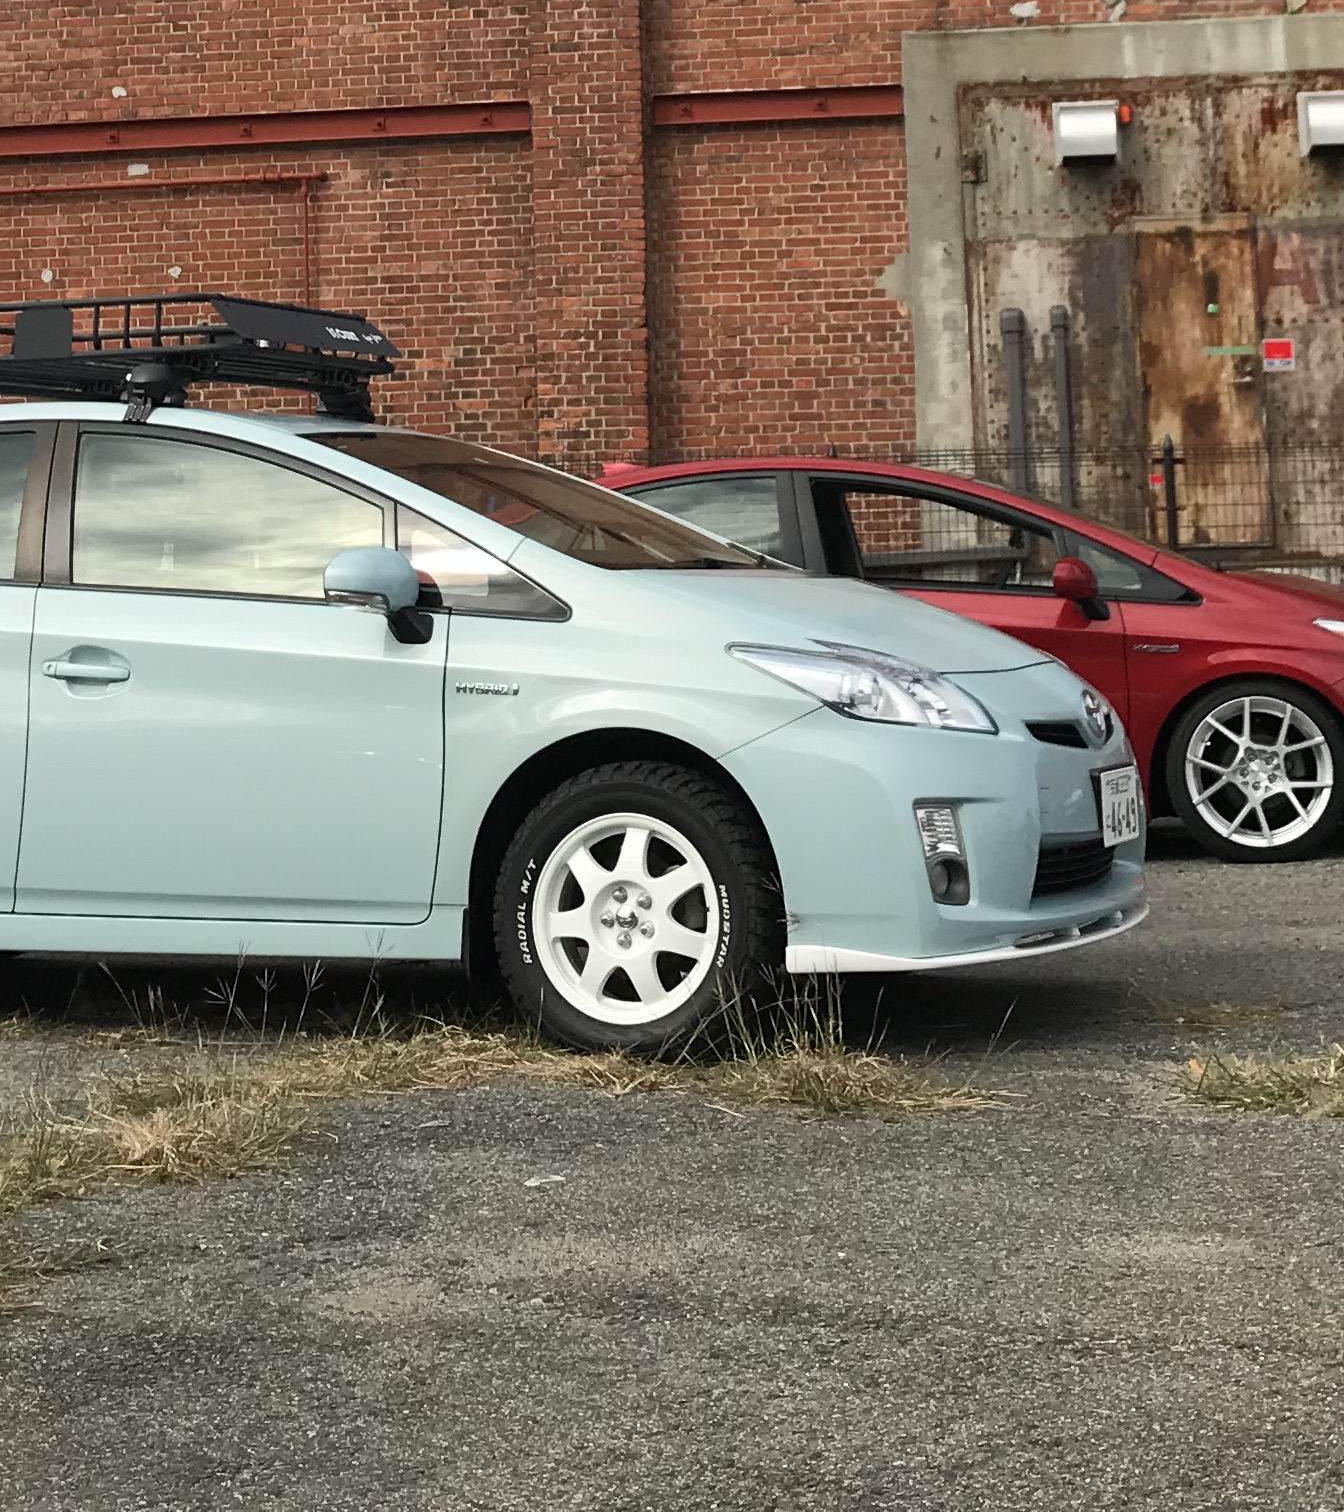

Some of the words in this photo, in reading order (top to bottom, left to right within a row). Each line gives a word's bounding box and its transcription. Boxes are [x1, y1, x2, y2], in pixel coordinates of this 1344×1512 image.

[455, 682, 512, 695] HYBRID
[520, 858, 537, 894] M/T
[517, 902, 533, 964] RADIAL
[716, 884, 731, 968] MUDSTAR
